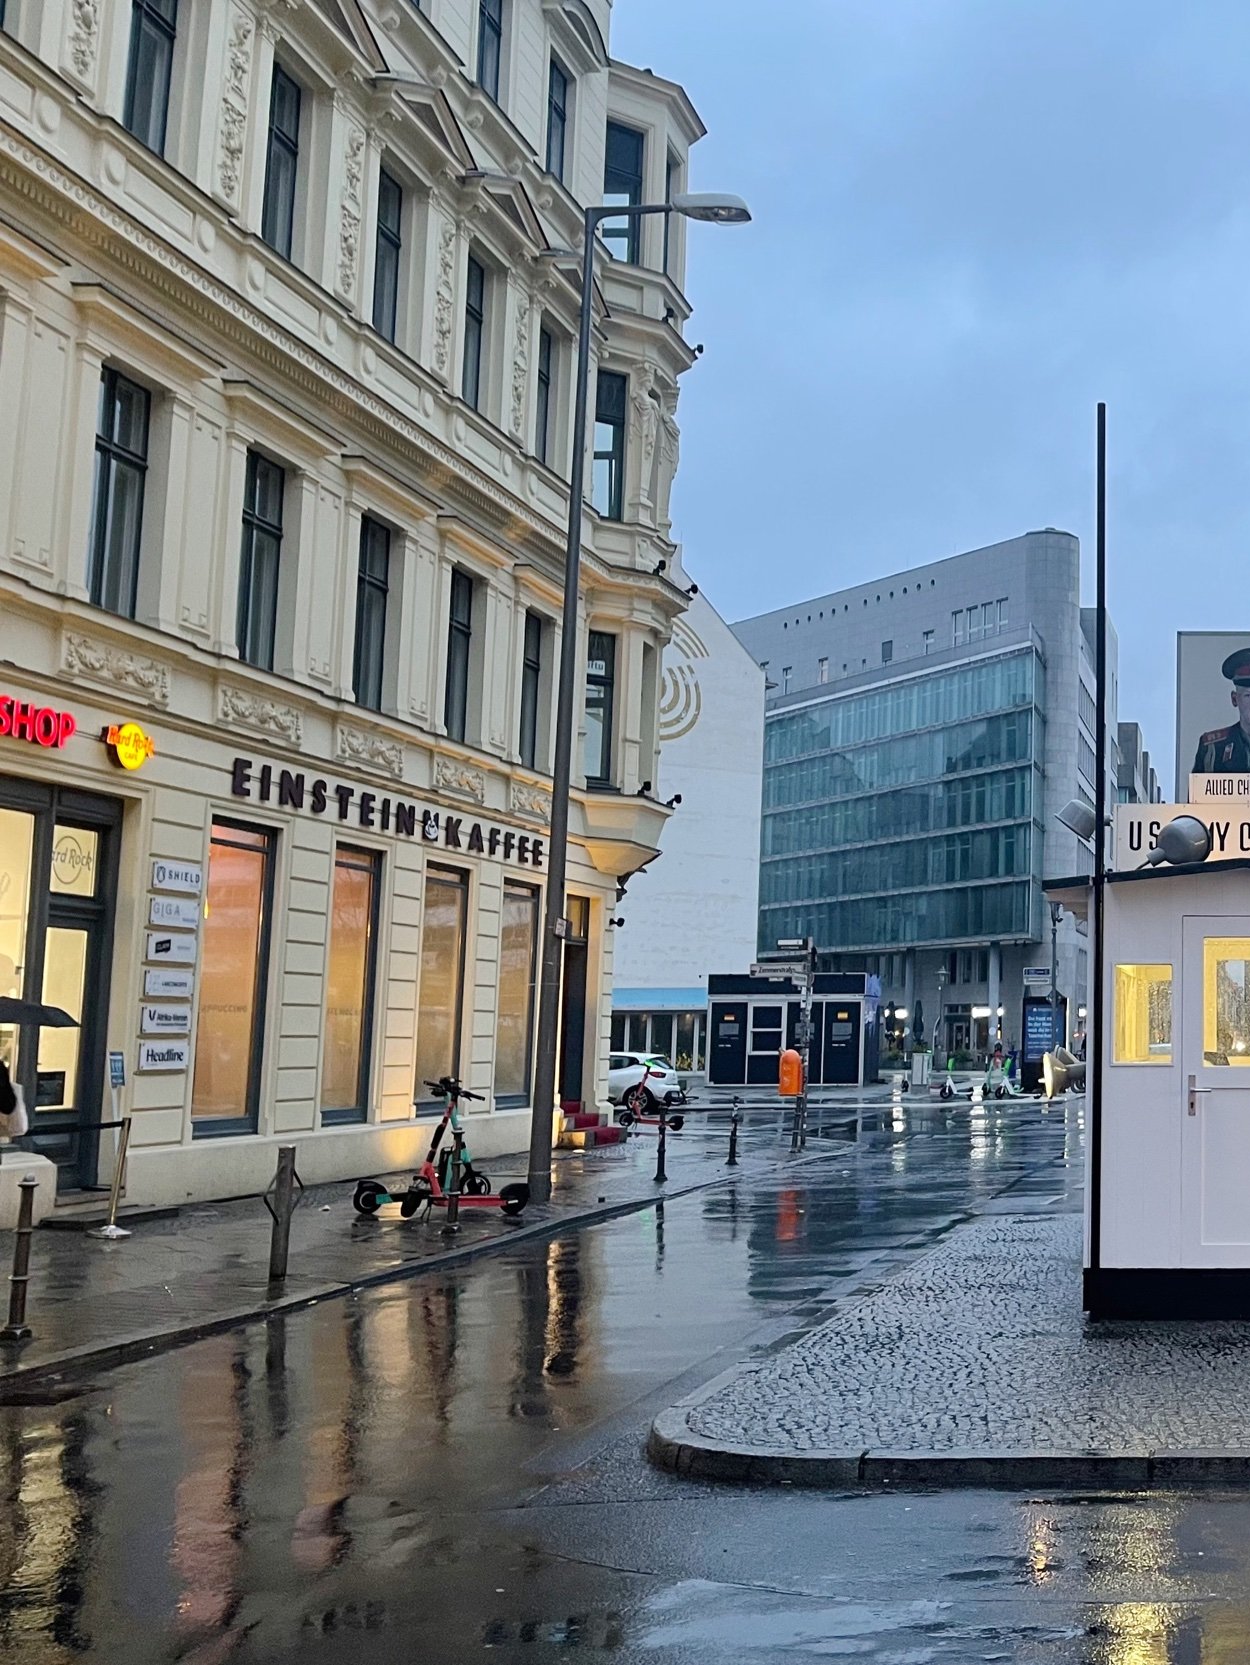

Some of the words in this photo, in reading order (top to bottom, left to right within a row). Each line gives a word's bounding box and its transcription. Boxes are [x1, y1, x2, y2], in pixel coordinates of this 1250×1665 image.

[0, 695, 75, 749] SHOP
[109, 726, 132, 747] Hard
[1204, 779, 1234, 796] ALLIED
[231, 757, 416, 837] EINSTEIN
[445, 815, 544, 867] KAFFEE
[51, 846, 68, 864] ard
[68, 847, 93, 872] Rock
[168, 869, 200, 884] SHIELD
[153, 902, 181, 918] GIGA
[145, 1048, 184, 1063] Headline
